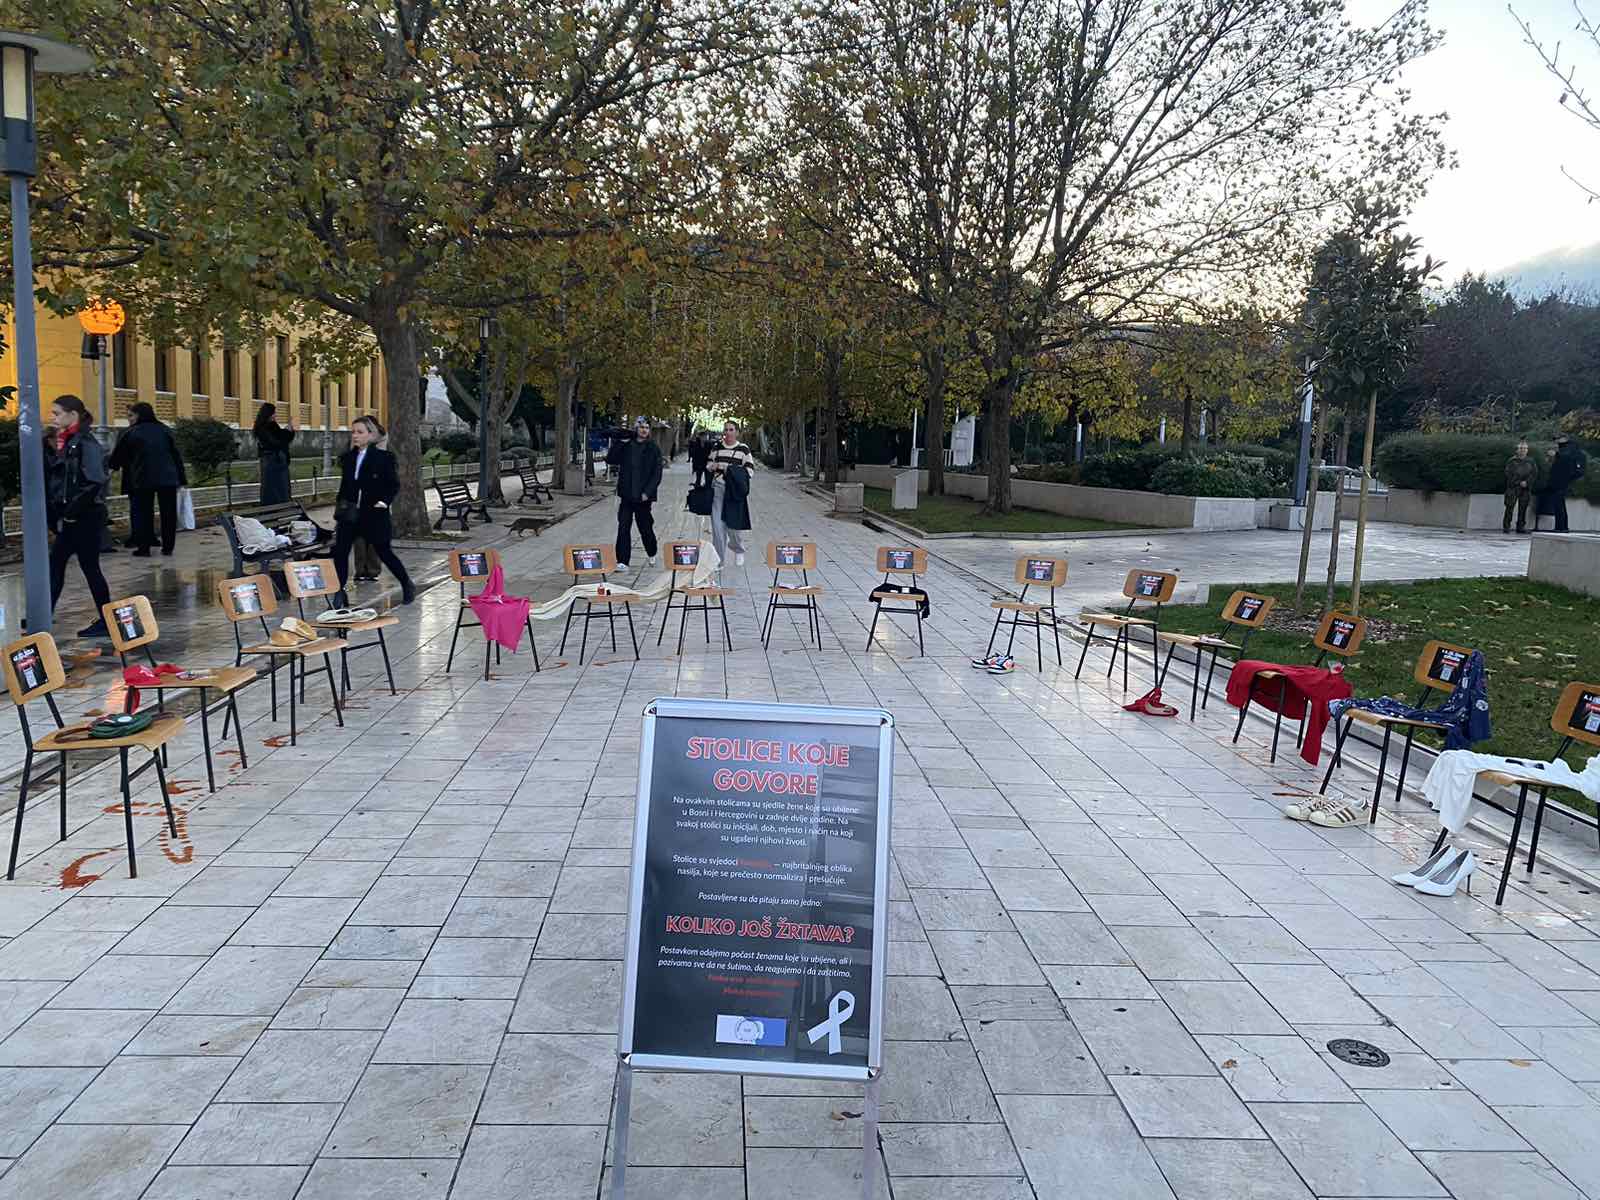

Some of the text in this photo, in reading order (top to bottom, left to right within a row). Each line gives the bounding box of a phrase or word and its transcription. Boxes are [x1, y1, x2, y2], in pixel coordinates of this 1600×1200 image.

[686, 736, 850, 767] STOLICE KOJE
[713, 768, 818, 796] GOVORE
[717, 799, 750, 807] stolicama
[762, 801, 785, 810] sjedile
[787, 802, 804, 810] žene
[806, 804, 820, 812] koje
[689, 808, 709, 816] Bosni
[715, 810, 758, 820] Hercegovini
[766, 814, 788, 822] zadnje
[790, 815, 808, 824] dvije
[676, 820, 699, 829] svakoj
[778, 826, 802, 835] mjesto
[840, 830, 854, 838] koji
[731, 835, 758, 844] ugašeni
[760, 836, 784, 846] njihovi
[672, 854, 697, 864] Stolice
[708, 857, 738, 866] svjedoci
[830, 864, 852, 872] oblika
[703, 868, 718, 878] koje
[764, 873, 804, 882] normalizira
[698, 892, 738, 902] Postavljene
[759, 896, 780, 906] pitaju
[666, 915, 855, 944] KOLIKO JOŠ ŽRTAVA?
[660, 946, 698, 956] Postavkom
[700, 948, 730, 958] odajemo
[730, 950, 755, 960] počast
[756, 952, 784, 961] ženama
[784, 953, 800, 964] koje
[839, 956, 848, 965] ali
[658, 958, 692, 968] pozivamo
[754, 964, 764, 972] da
[765, 966, 802, 975] reagujemo
[807, 967, 816, 975] da
